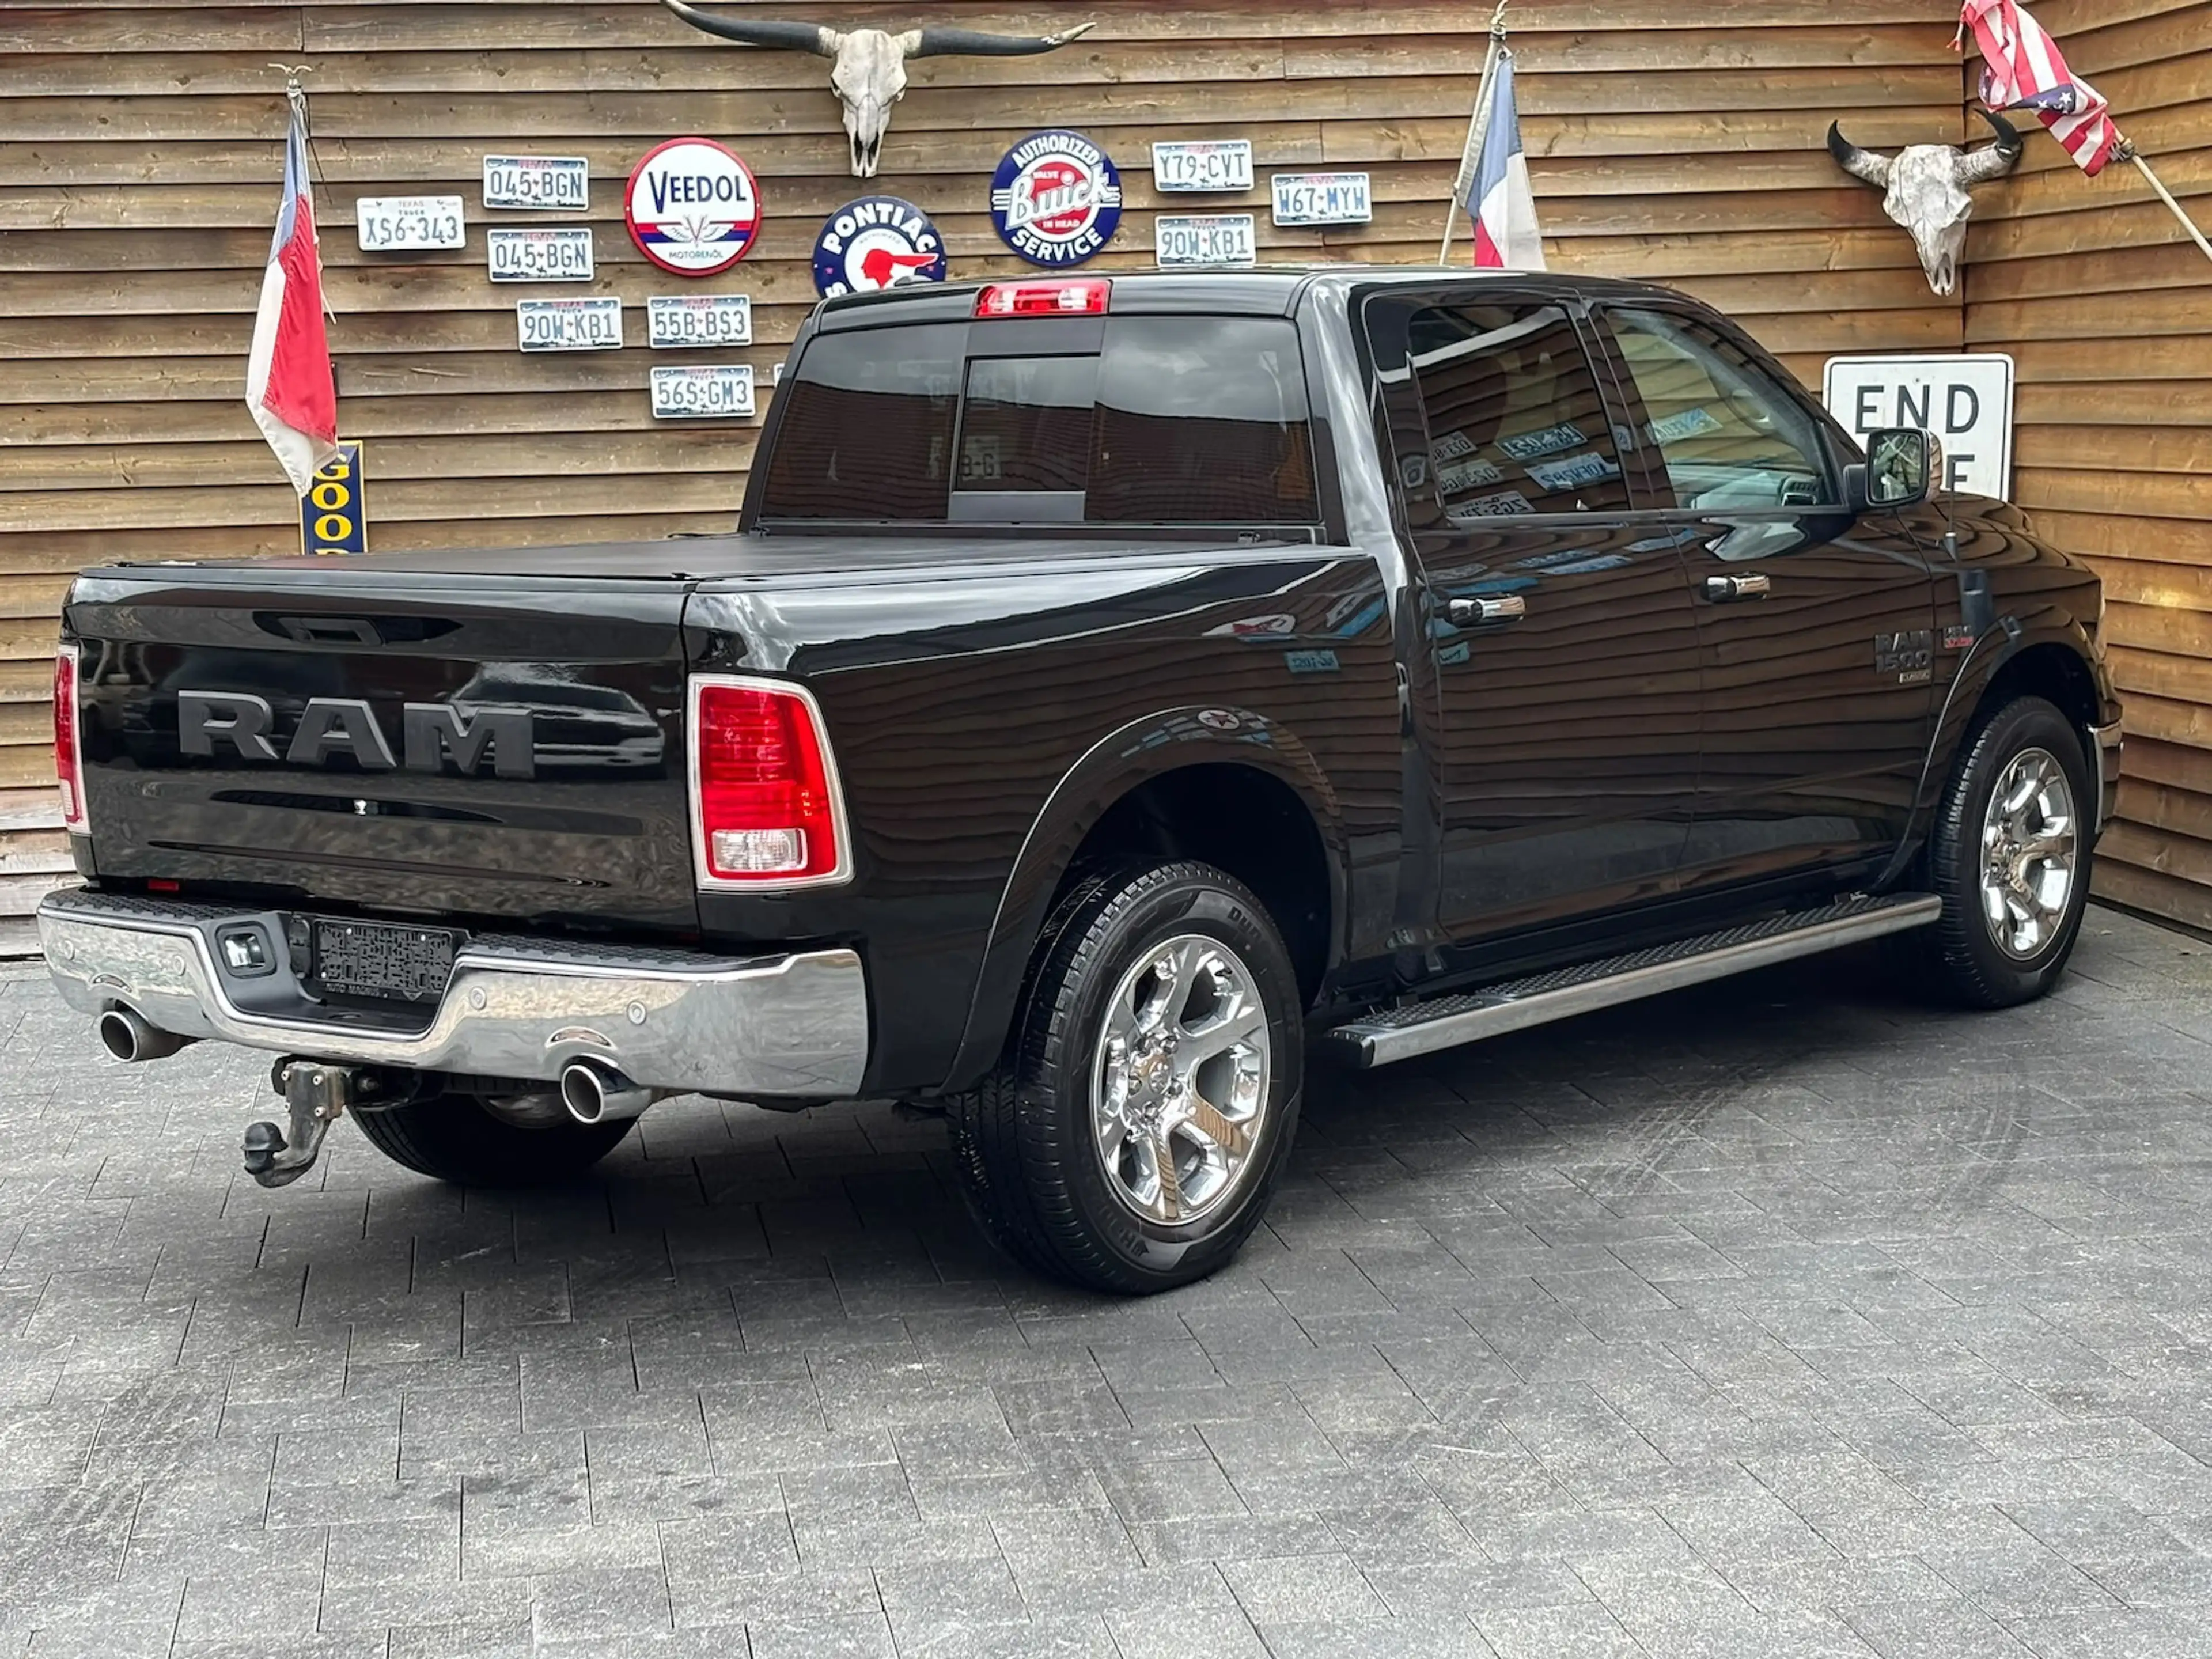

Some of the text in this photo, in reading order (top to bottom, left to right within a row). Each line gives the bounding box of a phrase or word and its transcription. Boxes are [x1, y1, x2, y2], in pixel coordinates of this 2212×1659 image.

[1012, 135, 1101, 169] AUTHORIZED
[648, 171, 747, 214] VEEDOL
[1005, 162, 1119, 231] Buick
[822, 203, 937, 255] PONTIAC
[1011, 227, 1103, 262] SERVICE
[1854, 384, 1980, 434] END
[312, 453, 353, 555] GOO
[178, 690, 536, 778] RAM
